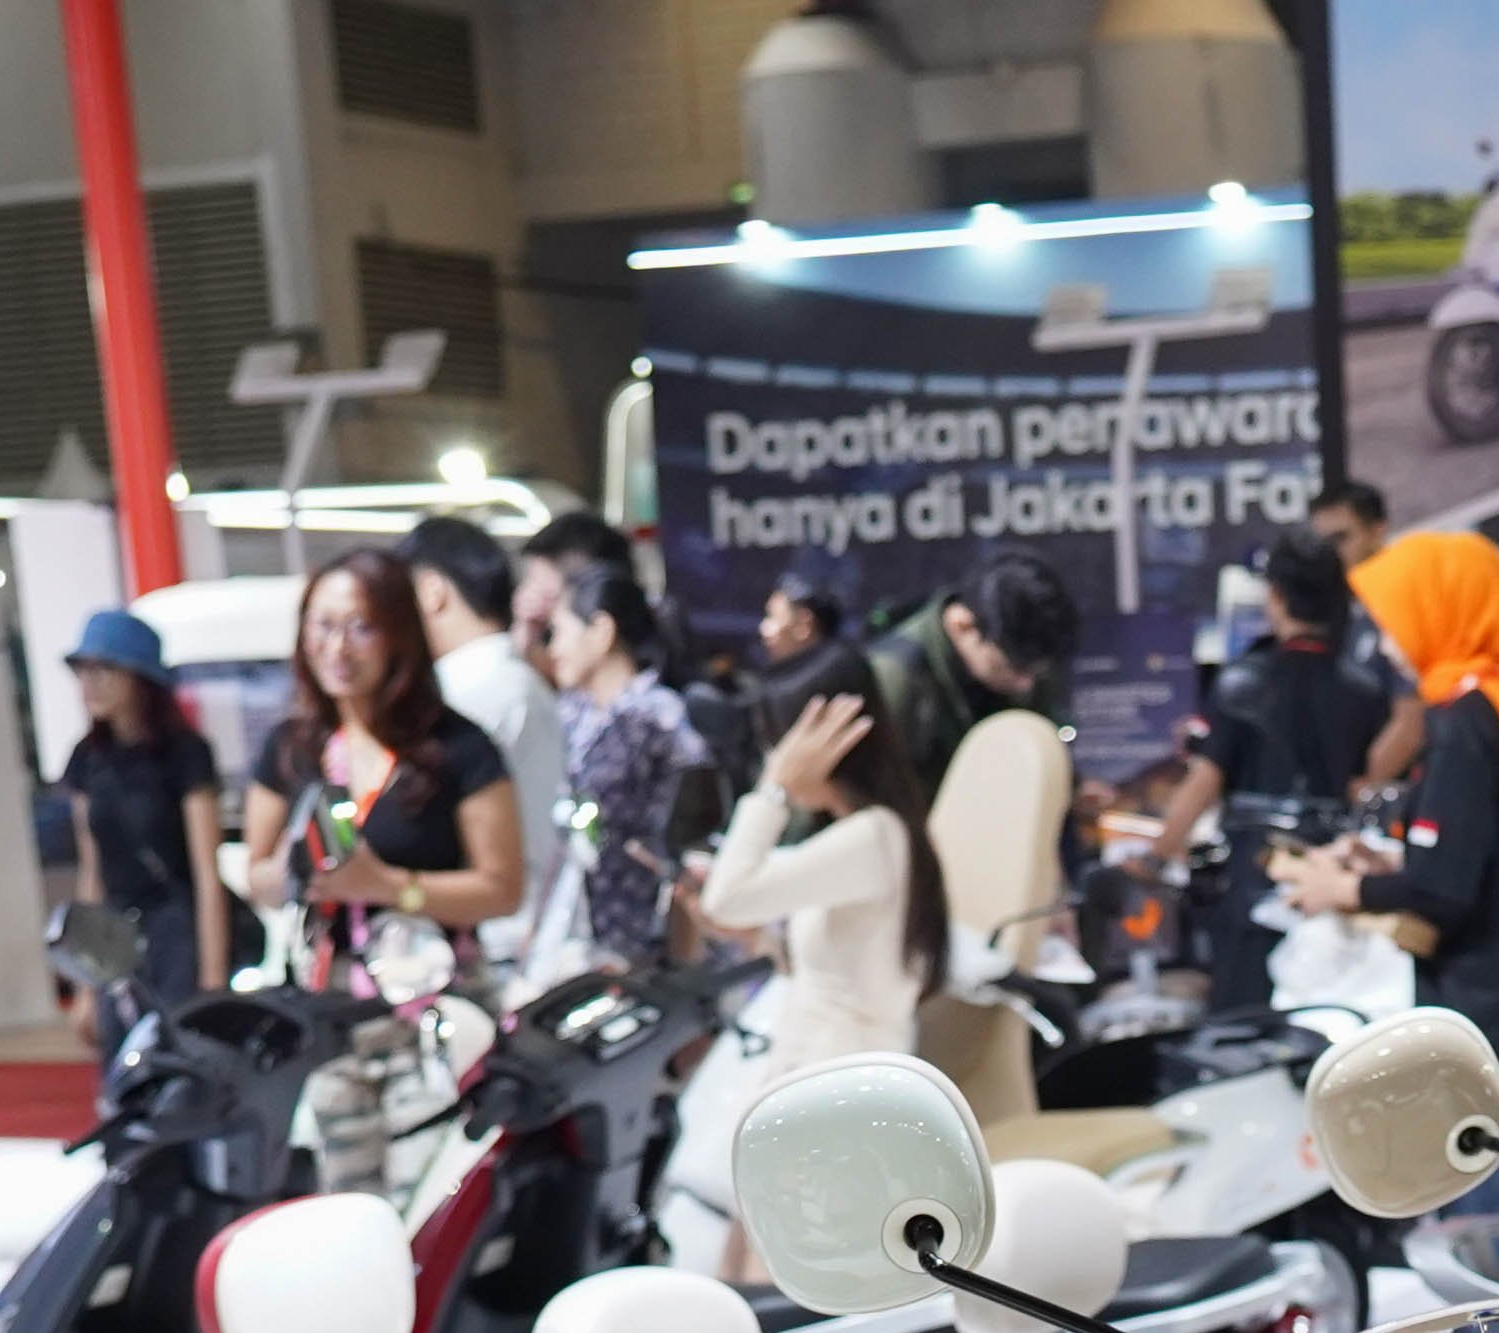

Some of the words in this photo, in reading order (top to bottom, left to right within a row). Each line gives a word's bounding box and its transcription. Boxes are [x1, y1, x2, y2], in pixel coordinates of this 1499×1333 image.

[705, 400, 1002, 483] Dapatkan
[710, 486, 899, 557] hanya
[903, 472, 965, 540] di
